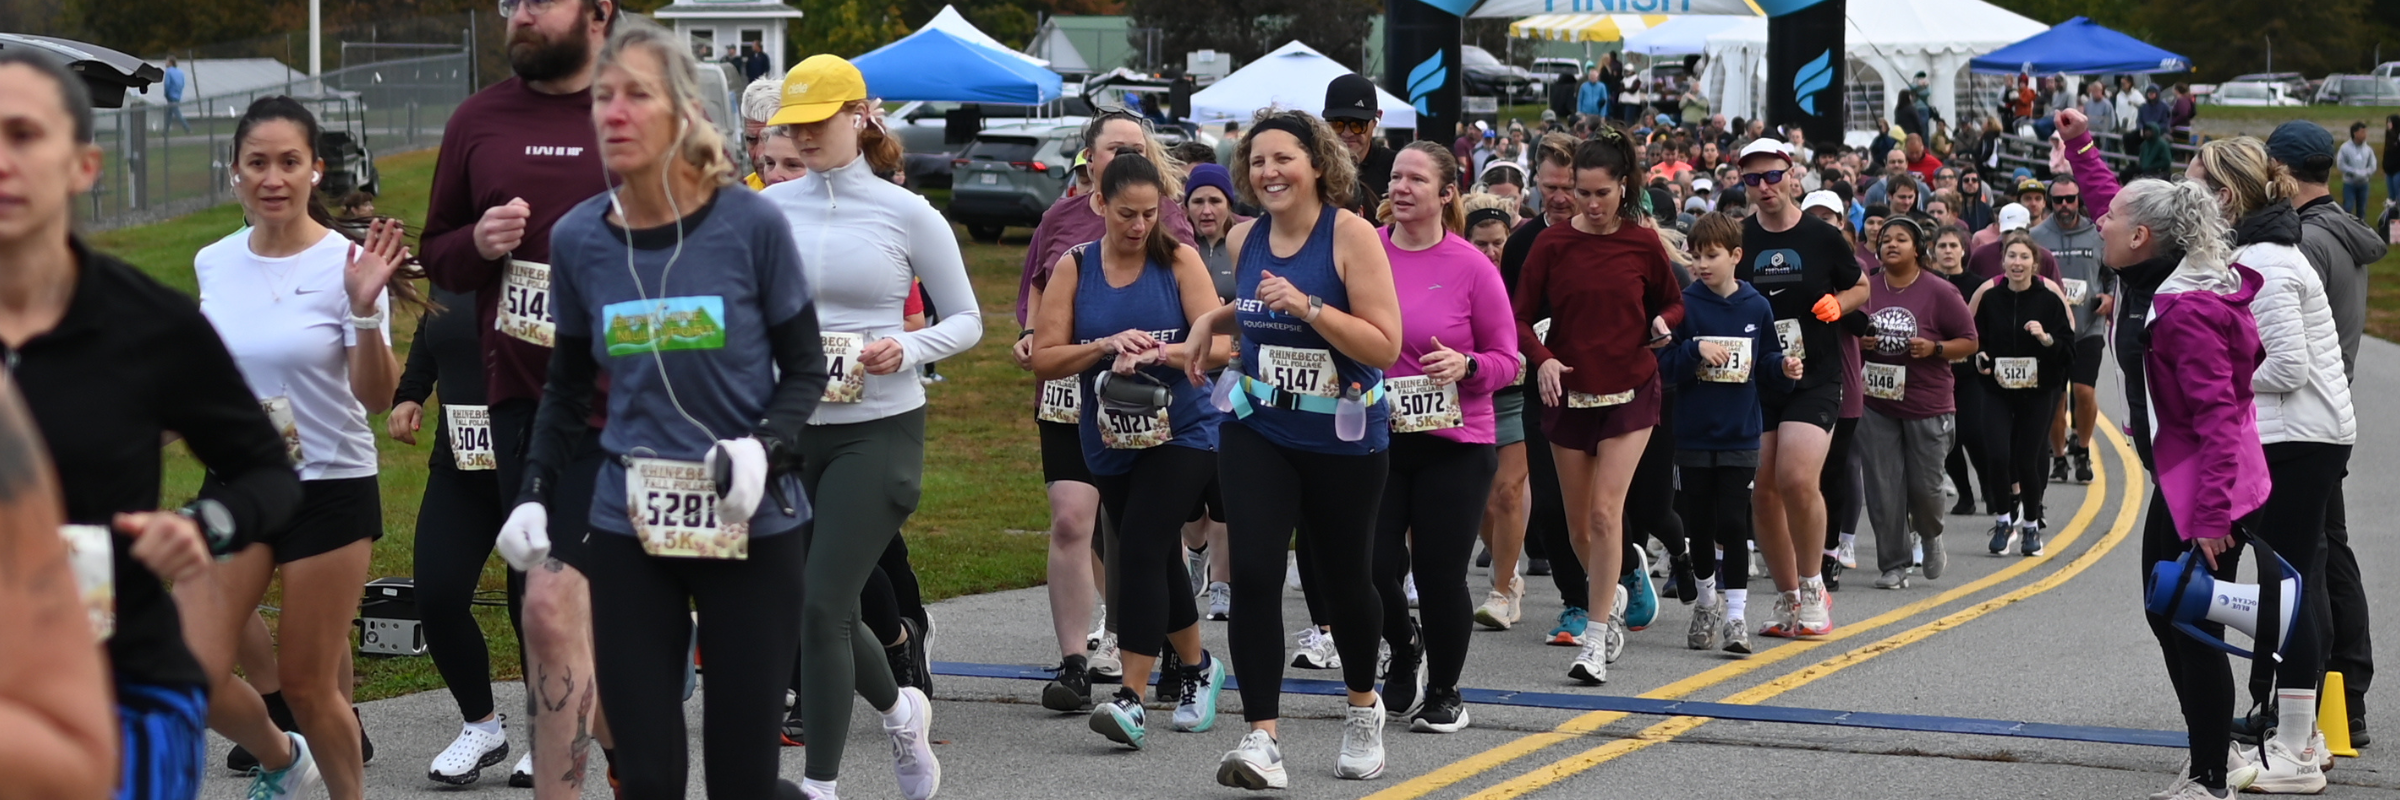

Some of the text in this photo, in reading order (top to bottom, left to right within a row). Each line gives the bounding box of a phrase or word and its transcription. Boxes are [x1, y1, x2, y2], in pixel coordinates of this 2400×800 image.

[508, 285, 553, 323] 514
[519, 320, 541, 338] 5K
[1148, 328, 1180, 341] EET
[1269, 349, 1327, 362] RHINEBECK
[1272, 359, 1323, 369] FALL FOLIAGE
[1275, 367, 1320, 391] 5147
[1715, 370, 1729, 379] 5K
[2004, 367, 2027, 380] 5121
[1868, 373, 1894, 389] 5148
[1045, 384, 1074, 409] 5176
[1401, 392, 1445, 416] 5072
[453, 409, 490, 418] RHINEBE
[1050, 407, 1063, 420] 5K
[469, 419, 490, 427] FOLIA
[1416, 415, 1433, 427] 5K
[457, 426, 494, 451] 504
[1125, 435, 1142, 446] 5K
[466, 453, 486, 466] 5K
[645, 479, 669, 489] FALL
[647, 491, 716, 528] 5281
[664, 531, 693, 549] 5K
[2231, 603, 2250, 612] BLUE
[2232, 596, 2257, 607] OCEAN
[2296, 765, 2318, 776] HOKA
